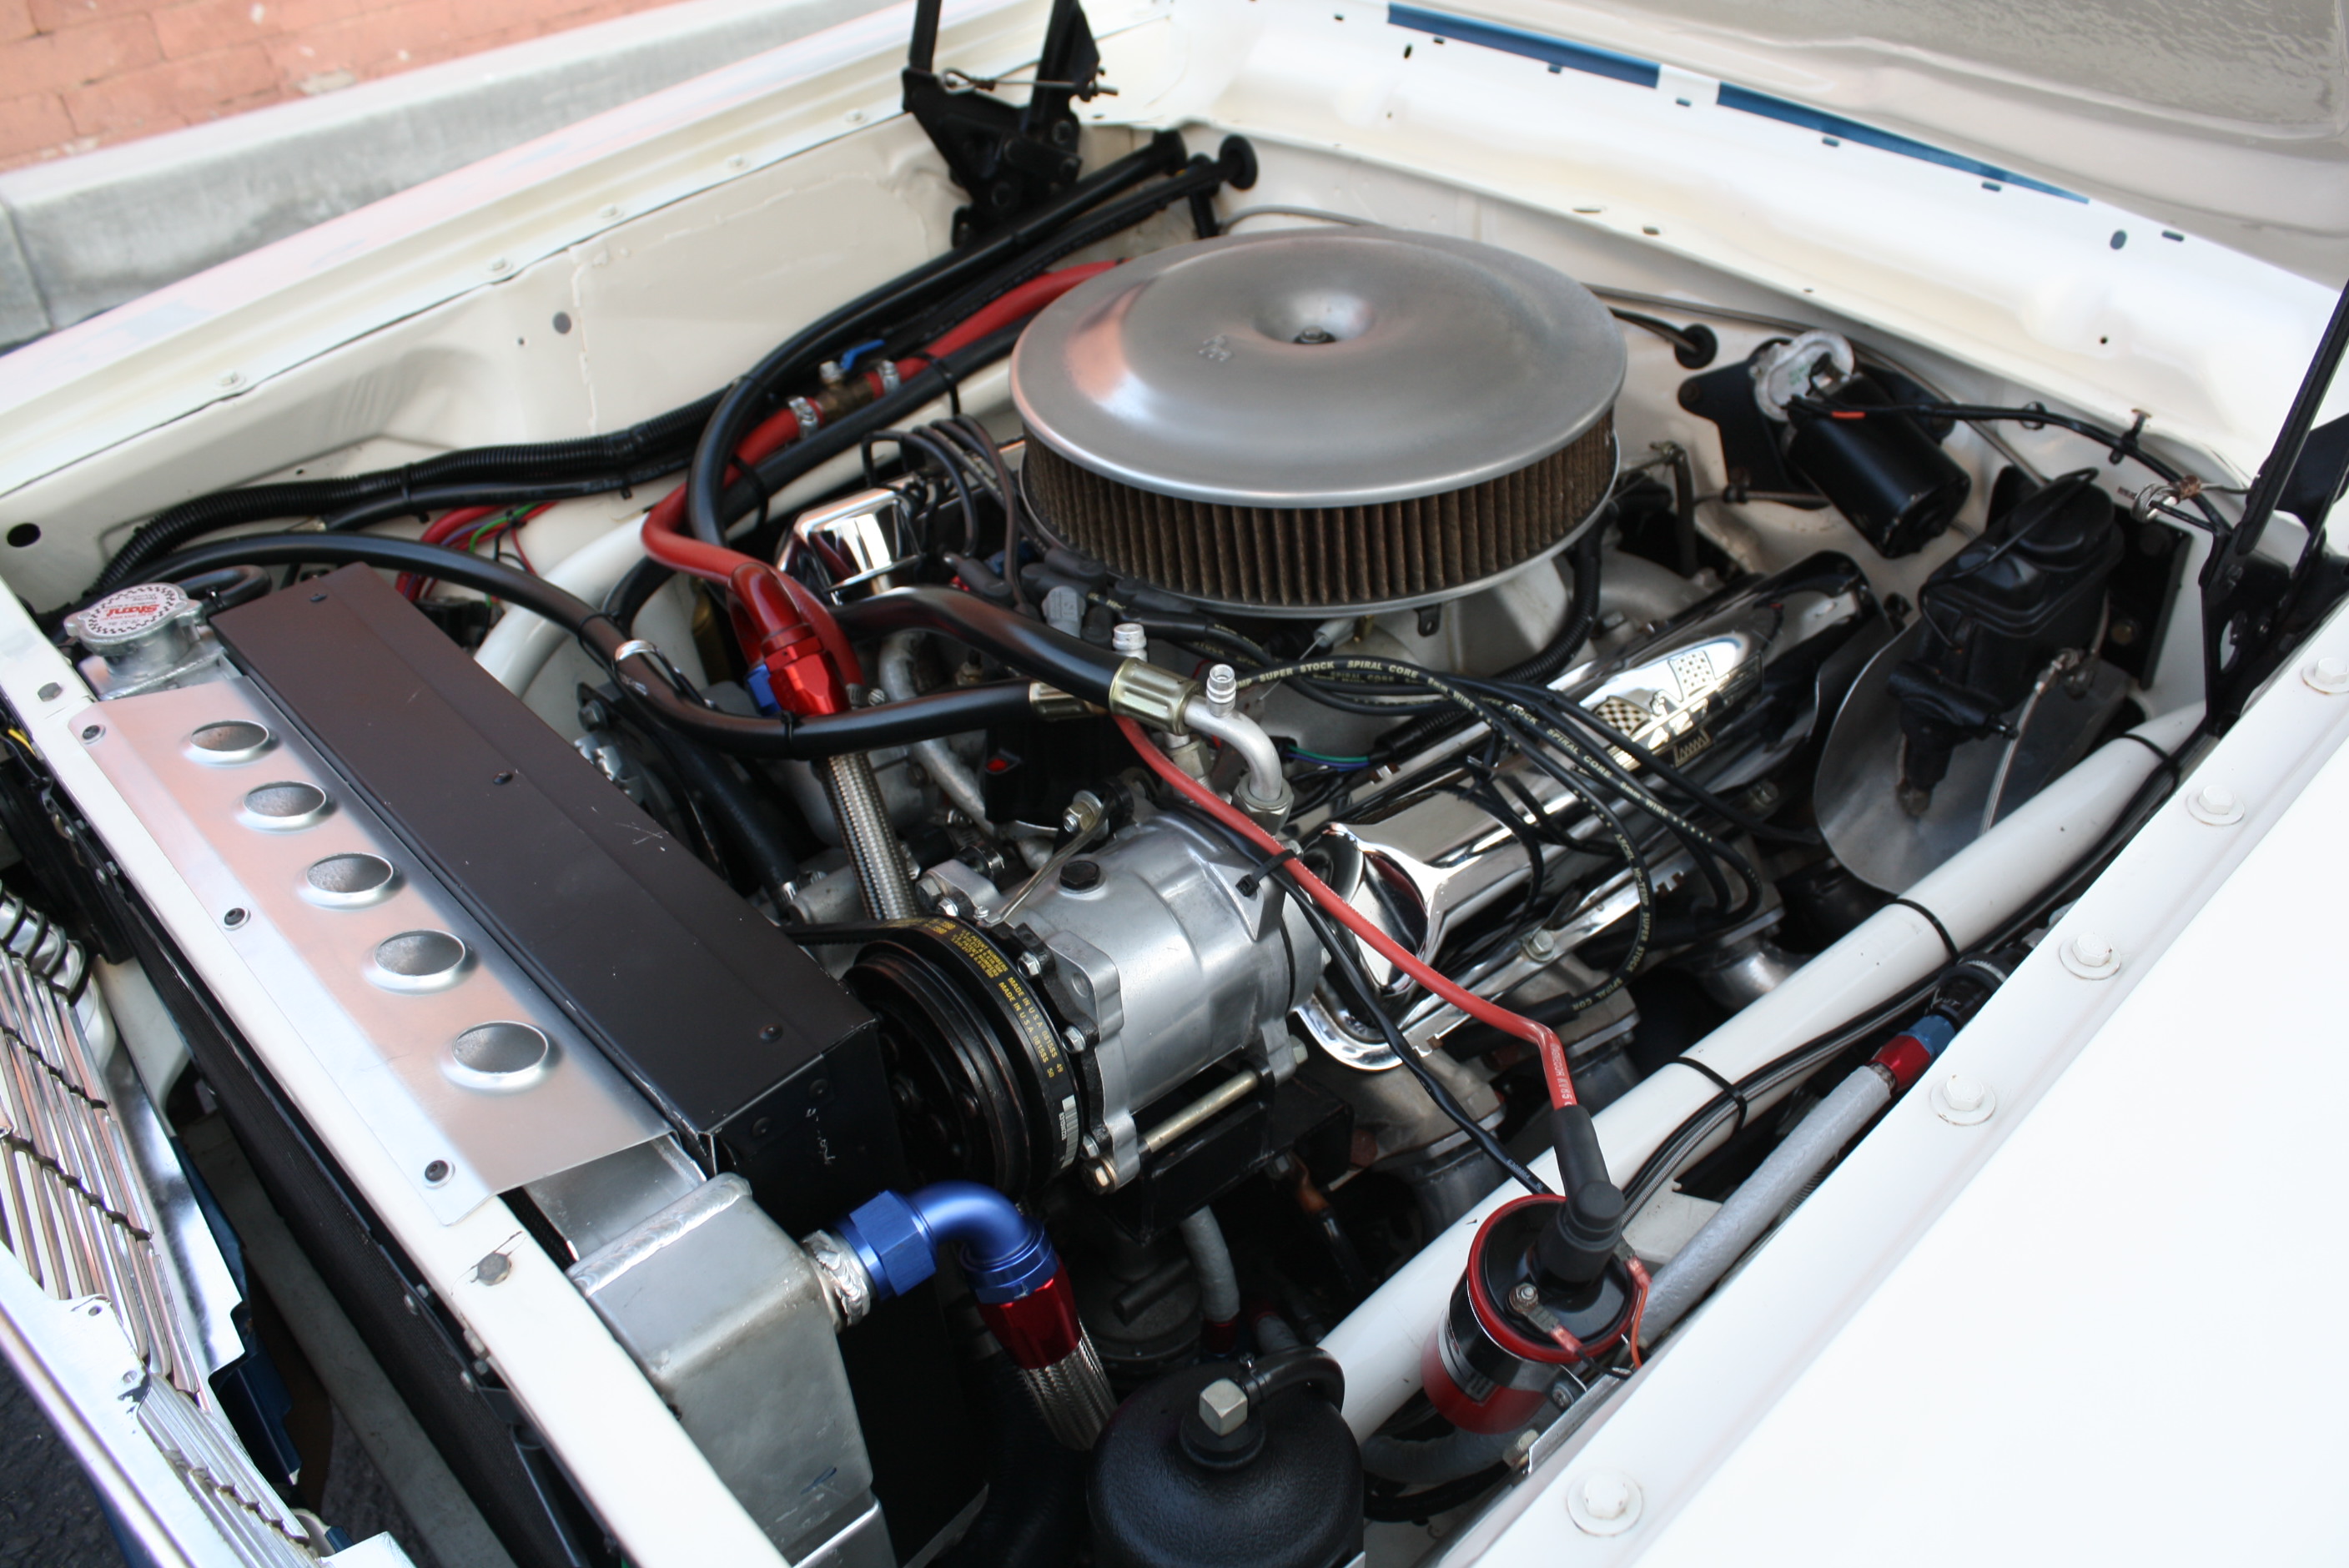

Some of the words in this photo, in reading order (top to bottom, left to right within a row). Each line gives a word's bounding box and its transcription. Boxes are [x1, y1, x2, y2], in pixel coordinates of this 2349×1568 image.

[1236, 677, 1253, 689] MP
[1259, 667, 1293, 682] SUPER
[1300, 660, 1335, 673] STOCK
[1347, 660, 1382, 671] SPIRAL
[1388, 664, 1418, 679] CORE
[1427, 676, 1449, 694] 8mm
[1452, 690, 1476, 711] WIRE
[1506, 705, 1539, 725] STOCK
[1547, 728, 1579, 755] SPIRAL
[1583, 756, 1612, 779] CORE
[1621, 781, 1642, 800] 8mm
[1645, 797, 1669, 817] WIRE
[1641, 912, 1650, 941] SUPER
[1626, 946, 1646, 972] STOCK
[1572, 998, 1592, 1012] COR
[1595, 977, 1624, 1000] SPIRAL
[998, 982, 1016, 1003] MADE
[1013, 1002, 1021, 1013] IN
[1047, 1067, 1055, 1078] 50
[1007, 977, 1025, 998] MADE
[1022, 996, 1031, 1008] IN
[1056, 1063, 1064, 1073] 49
